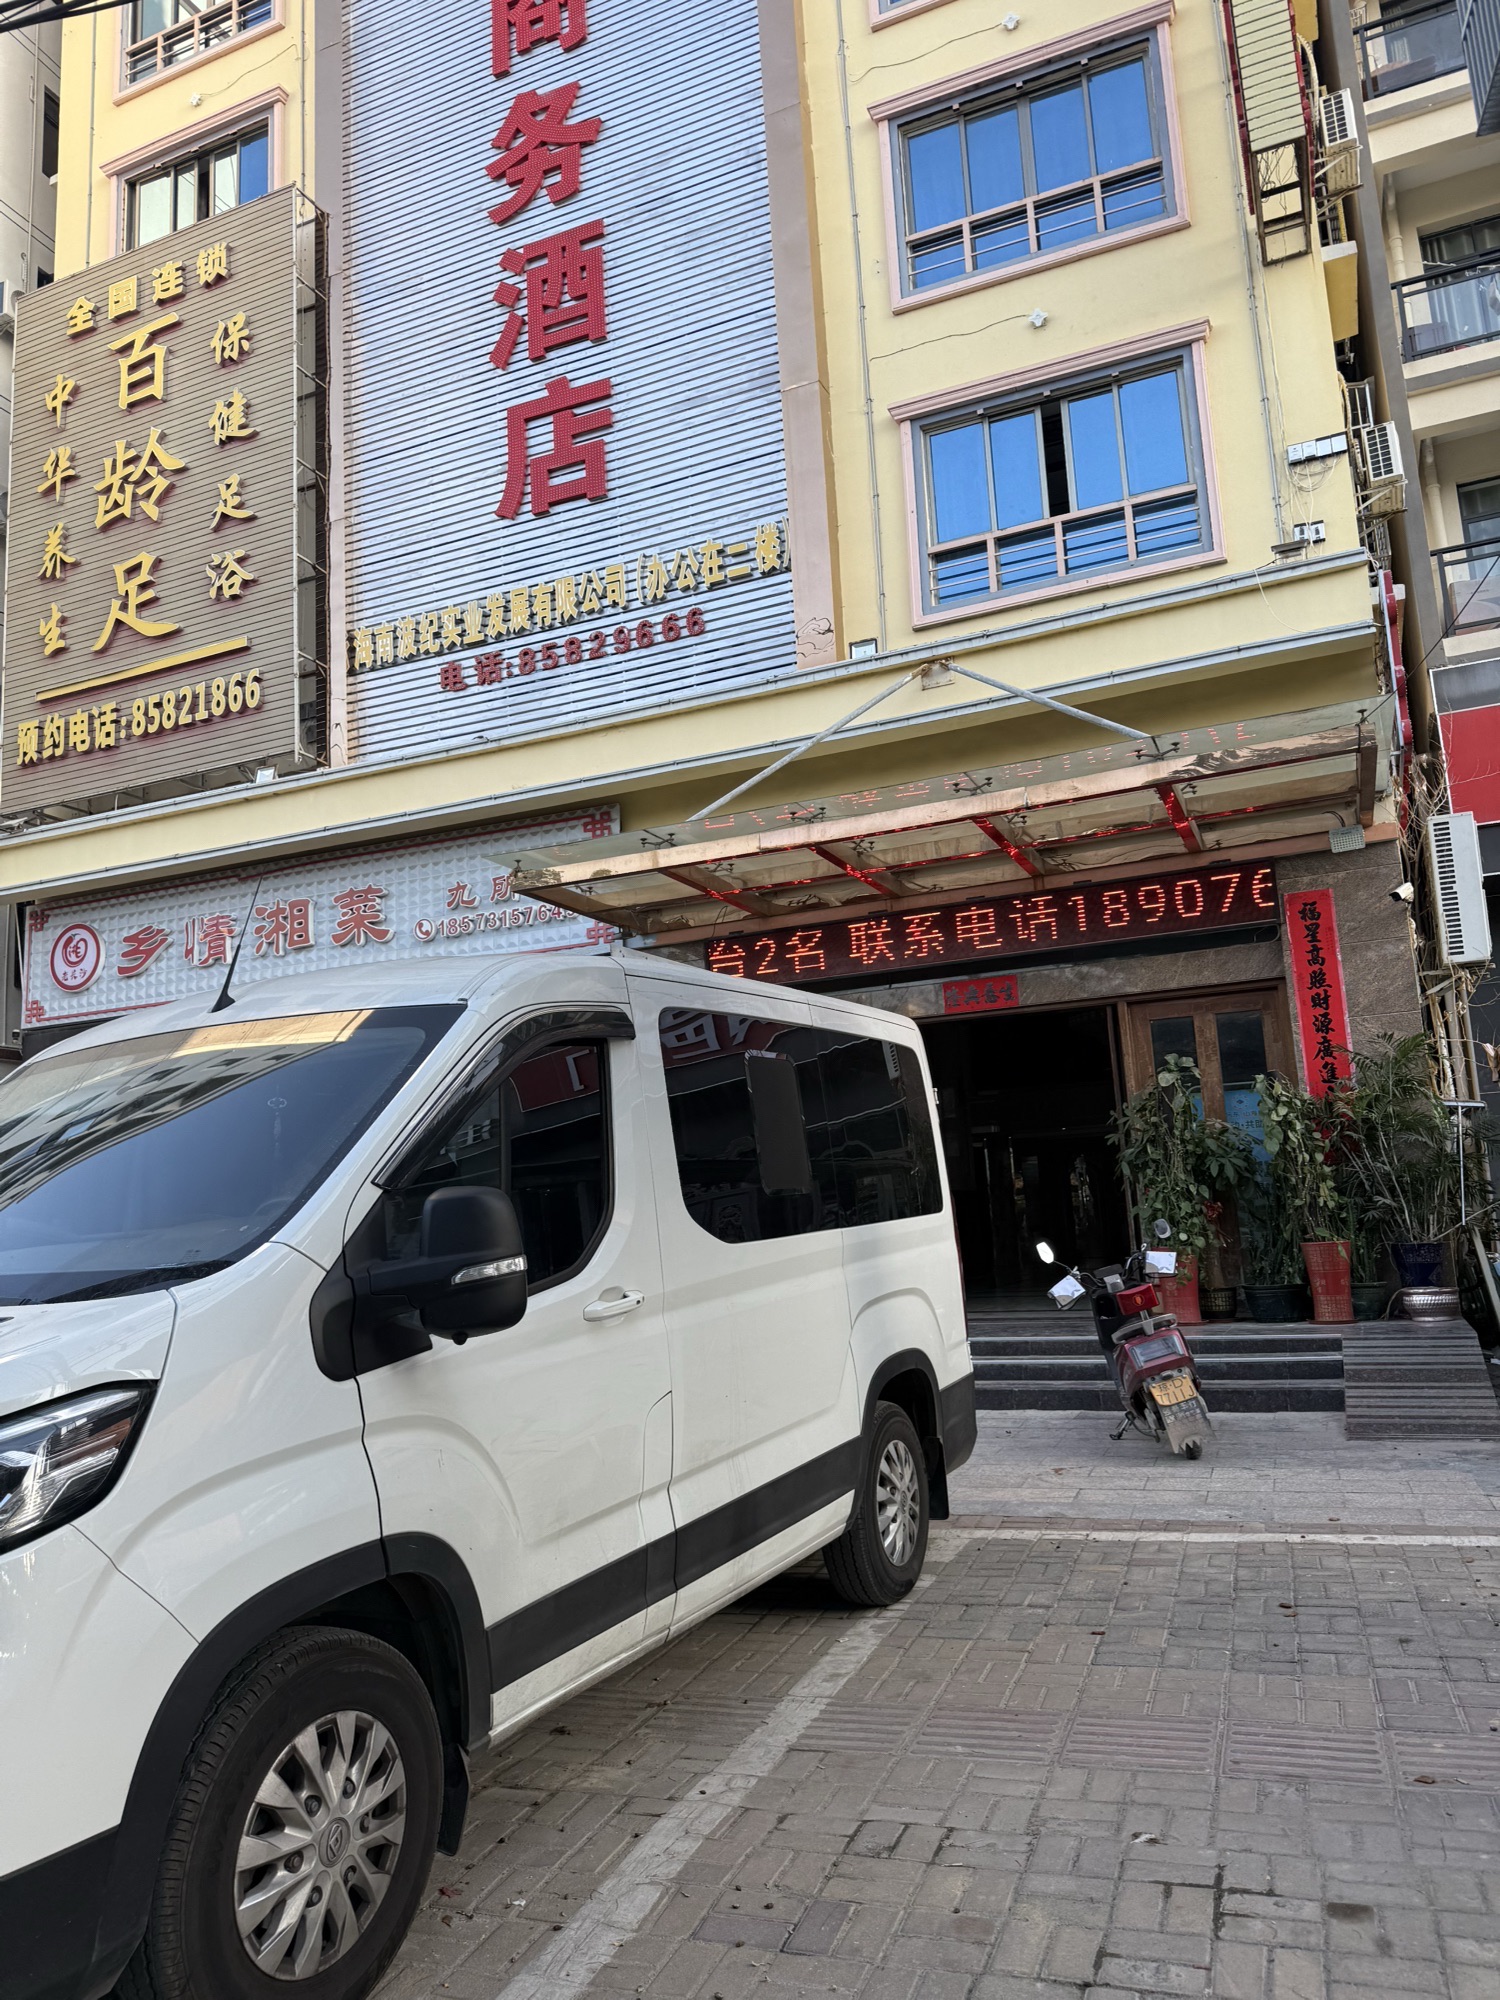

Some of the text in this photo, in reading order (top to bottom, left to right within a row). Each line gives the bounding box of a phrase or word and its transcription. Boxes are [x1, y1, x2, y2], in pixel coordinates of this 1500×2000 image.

[66, 241, 233, 337] 全国连锁
[37, 373, 80, 657] 中华养生
[91, 311, 187, 652] 百龄足
[205, 311, 259, 601] 保健足浴
[16, 668, 262, 766] 预约电话:85821866
[116, 885, 396, 978] 乡情湘菜
[1298, 901, 1341, 1094] 福星高照財源廣進
[1156, 1385, 1195, 1403] 7711J
